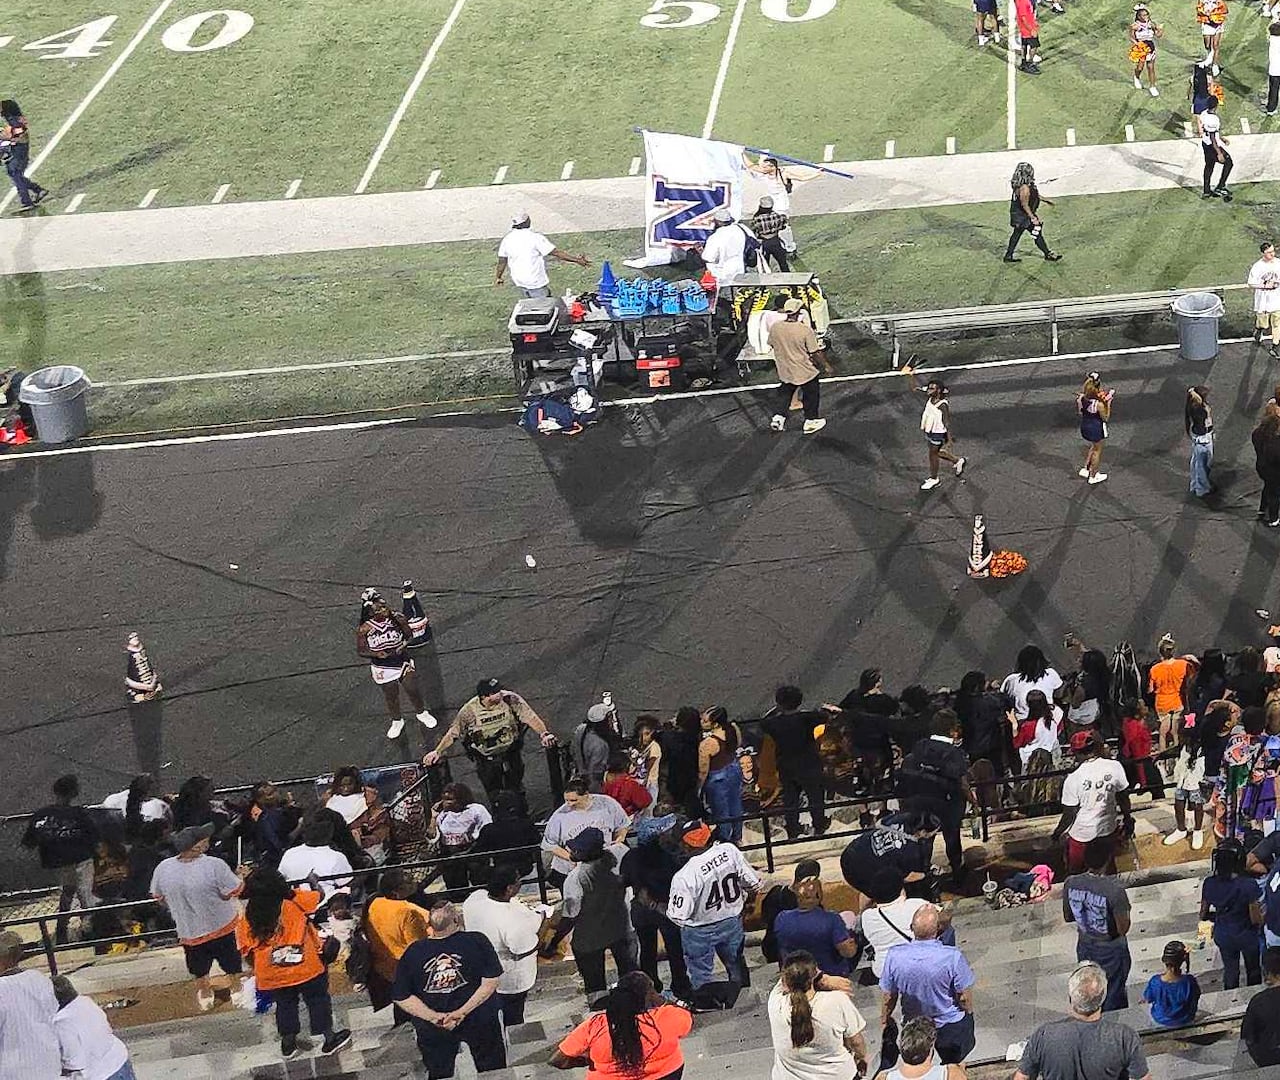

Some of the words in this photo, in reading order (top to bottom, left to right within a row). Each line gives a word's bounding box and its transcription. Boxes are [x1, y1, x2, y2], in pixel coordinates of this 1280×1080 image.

[21, 1, 246, 50] 40
[646, 175, 734, 249] N
[480, 712, 506, 724] SHERIFF
[672, 893, 684, 909] 40
[704, 872, 741, 913] 40
